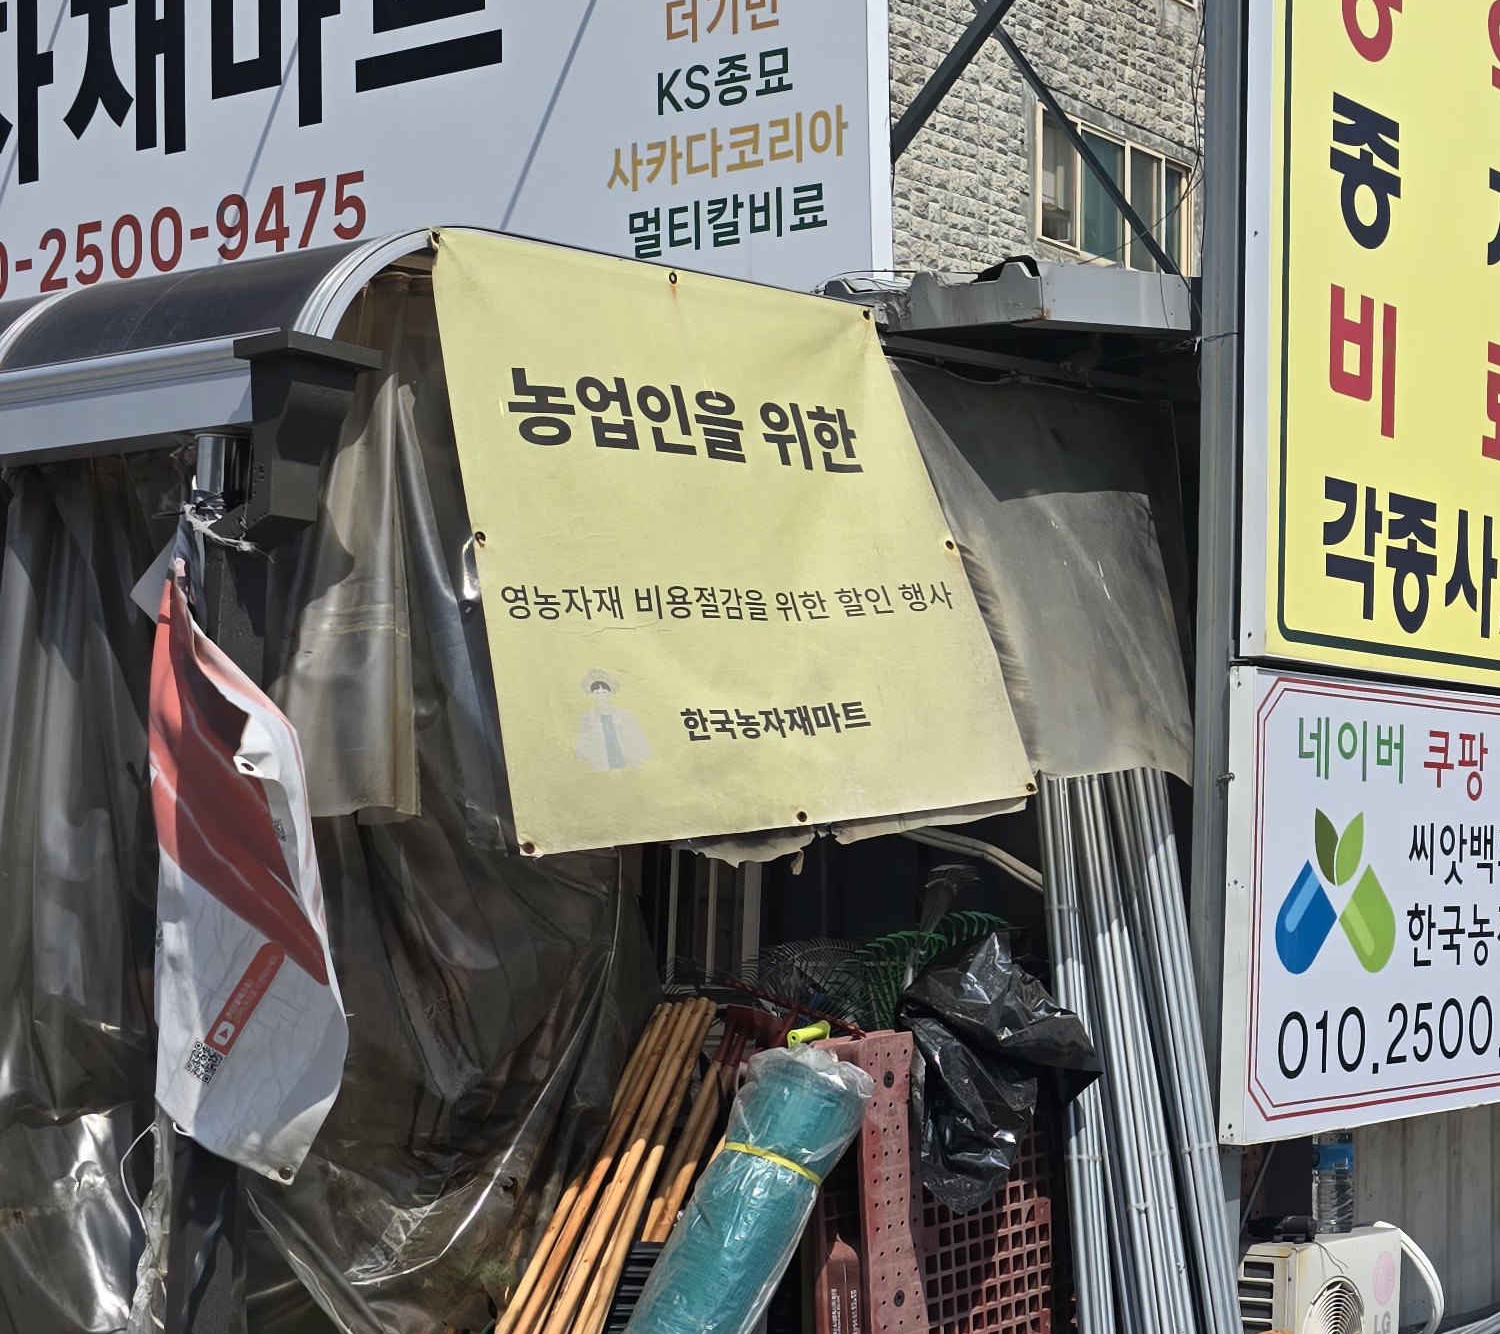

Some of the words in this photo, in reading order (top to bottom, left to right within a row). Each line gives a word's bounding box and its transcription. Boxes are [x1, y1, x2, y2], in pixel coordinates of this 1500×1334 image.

[657, 47, 793, 115] KS종묘
[606, 104, 849, 192] 사카다코리아
[0, 170, 367, 299] -2500-9475
[629, 183, 828, 259] 멀티칼비료
[508, 367, 747, 465] 농업인을
[758, 401, 865, 474] 위한
[500, 585, 625, 621] 영농자재
[634, 584, 769, 622] 비용절감을
[775, 589, 829, 622] 위한
[834, 585, 895, 619] 할인
[898, 580, 955, 612] 행사
[680, 700, 871, 742] 한국농자재마트
[1298, 716, 1405, 784] 네이버
[1424, 729, 1488, 801] 쿠팡
